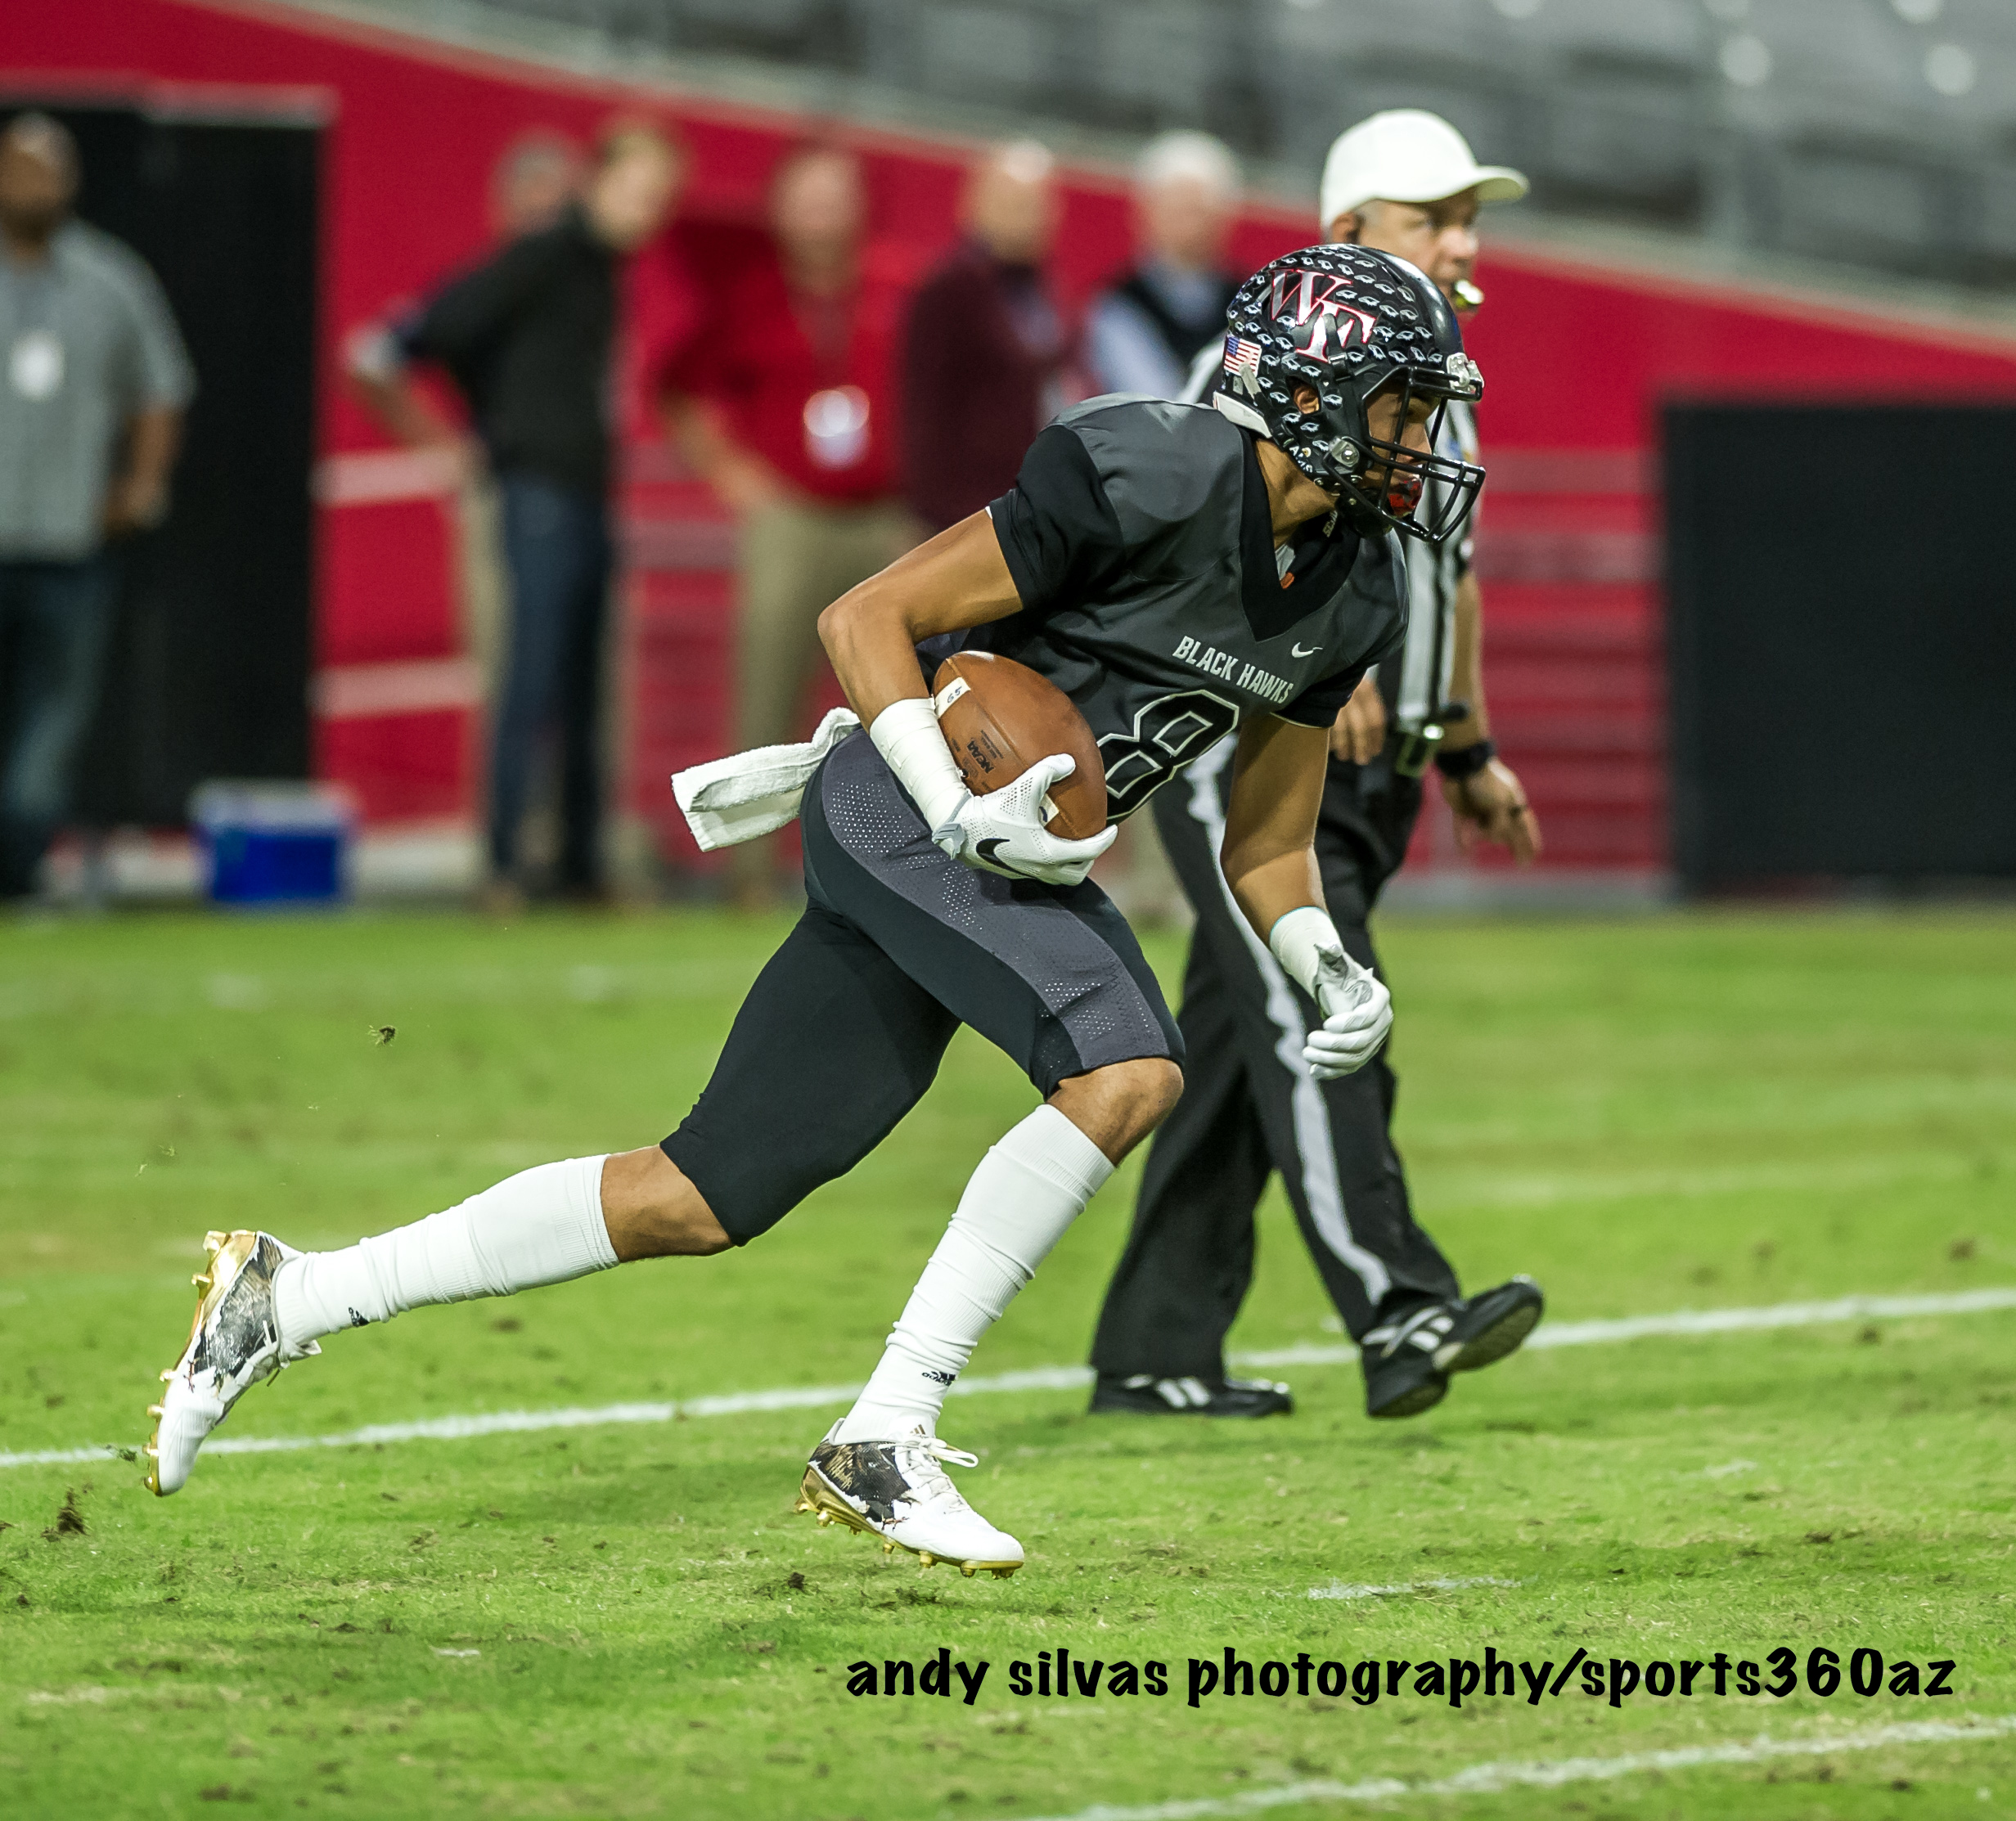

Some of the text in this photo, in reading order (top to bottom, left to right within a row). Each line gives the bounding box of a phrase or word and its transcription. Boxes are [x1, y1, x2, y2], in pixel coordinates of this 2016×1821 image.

[1172, 636, 1294, 704] BLACK HAWKS
[967, 740, 995, 773] NCAA
[1097, 690, 1239, 820] 8
